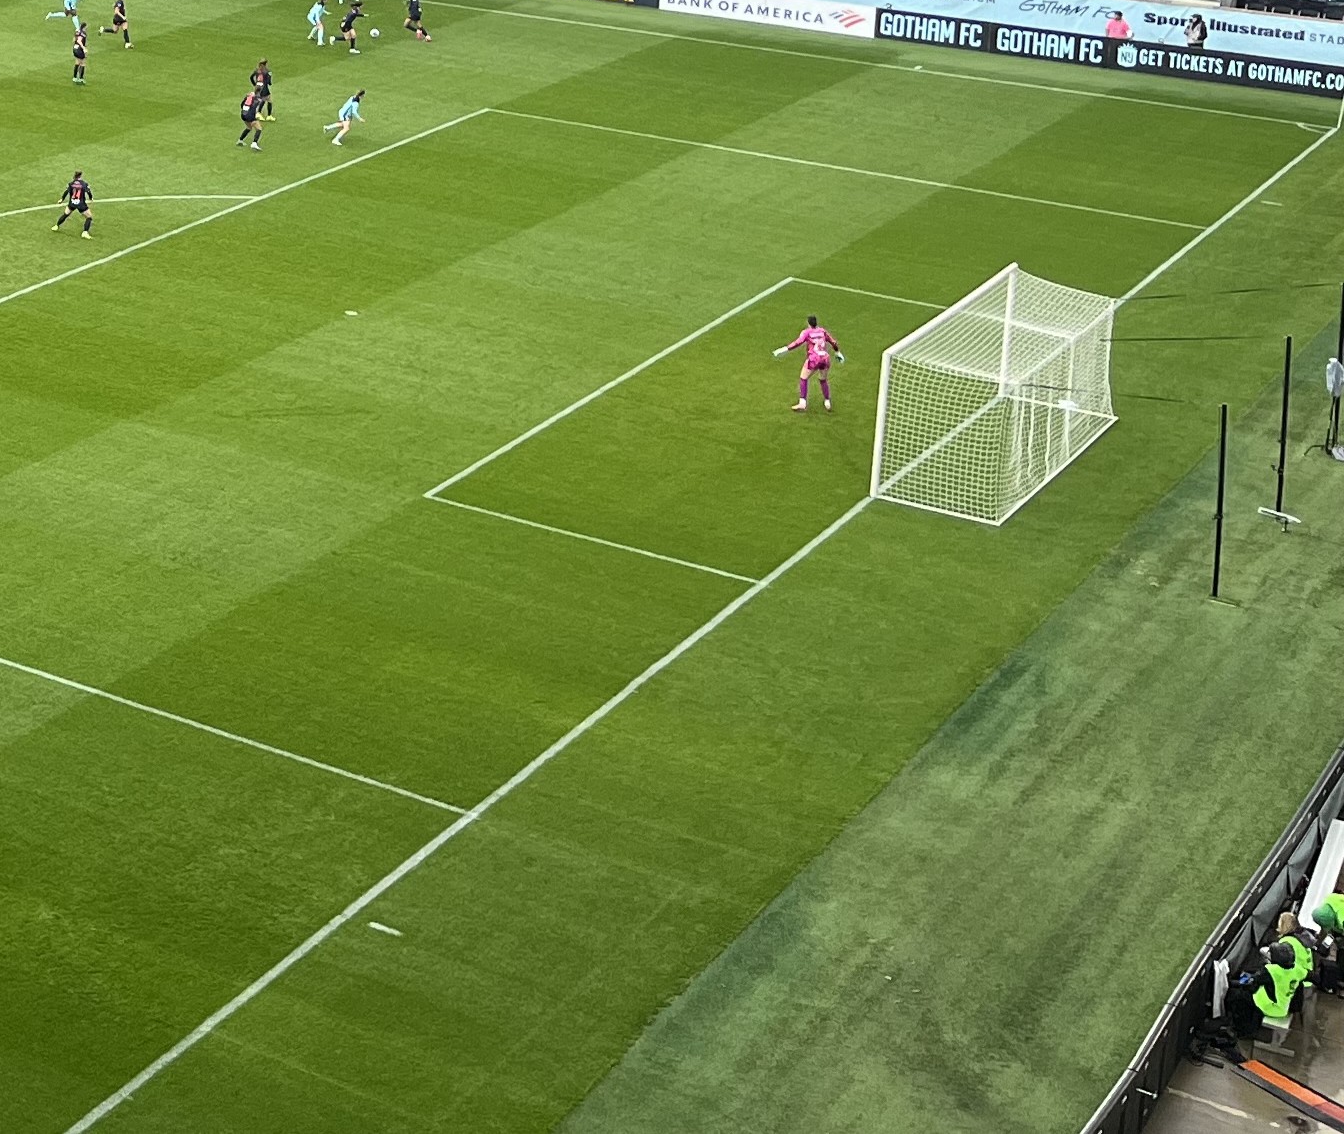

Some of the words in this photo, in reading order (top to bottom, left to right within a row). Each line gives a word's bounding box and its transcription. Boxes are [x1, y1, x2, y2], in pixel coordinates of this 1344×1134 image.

[718, 0, 739, 14] OF
[743, 4, 824, 25] AMERICA
[879, 12, 956, 44] GOTHAM
[958, 22, 983, 48] FC
[1209, 18, 1305, 41] Illustrated
[996, 28, 1076, 60] GOTHAM
[1078, 38, 1103, 64] FC
[1138, 46, 1165, 66] GET
[1168, 50, 1224, 75] TICKETS
[1226, 59, 1244, 78] AT
